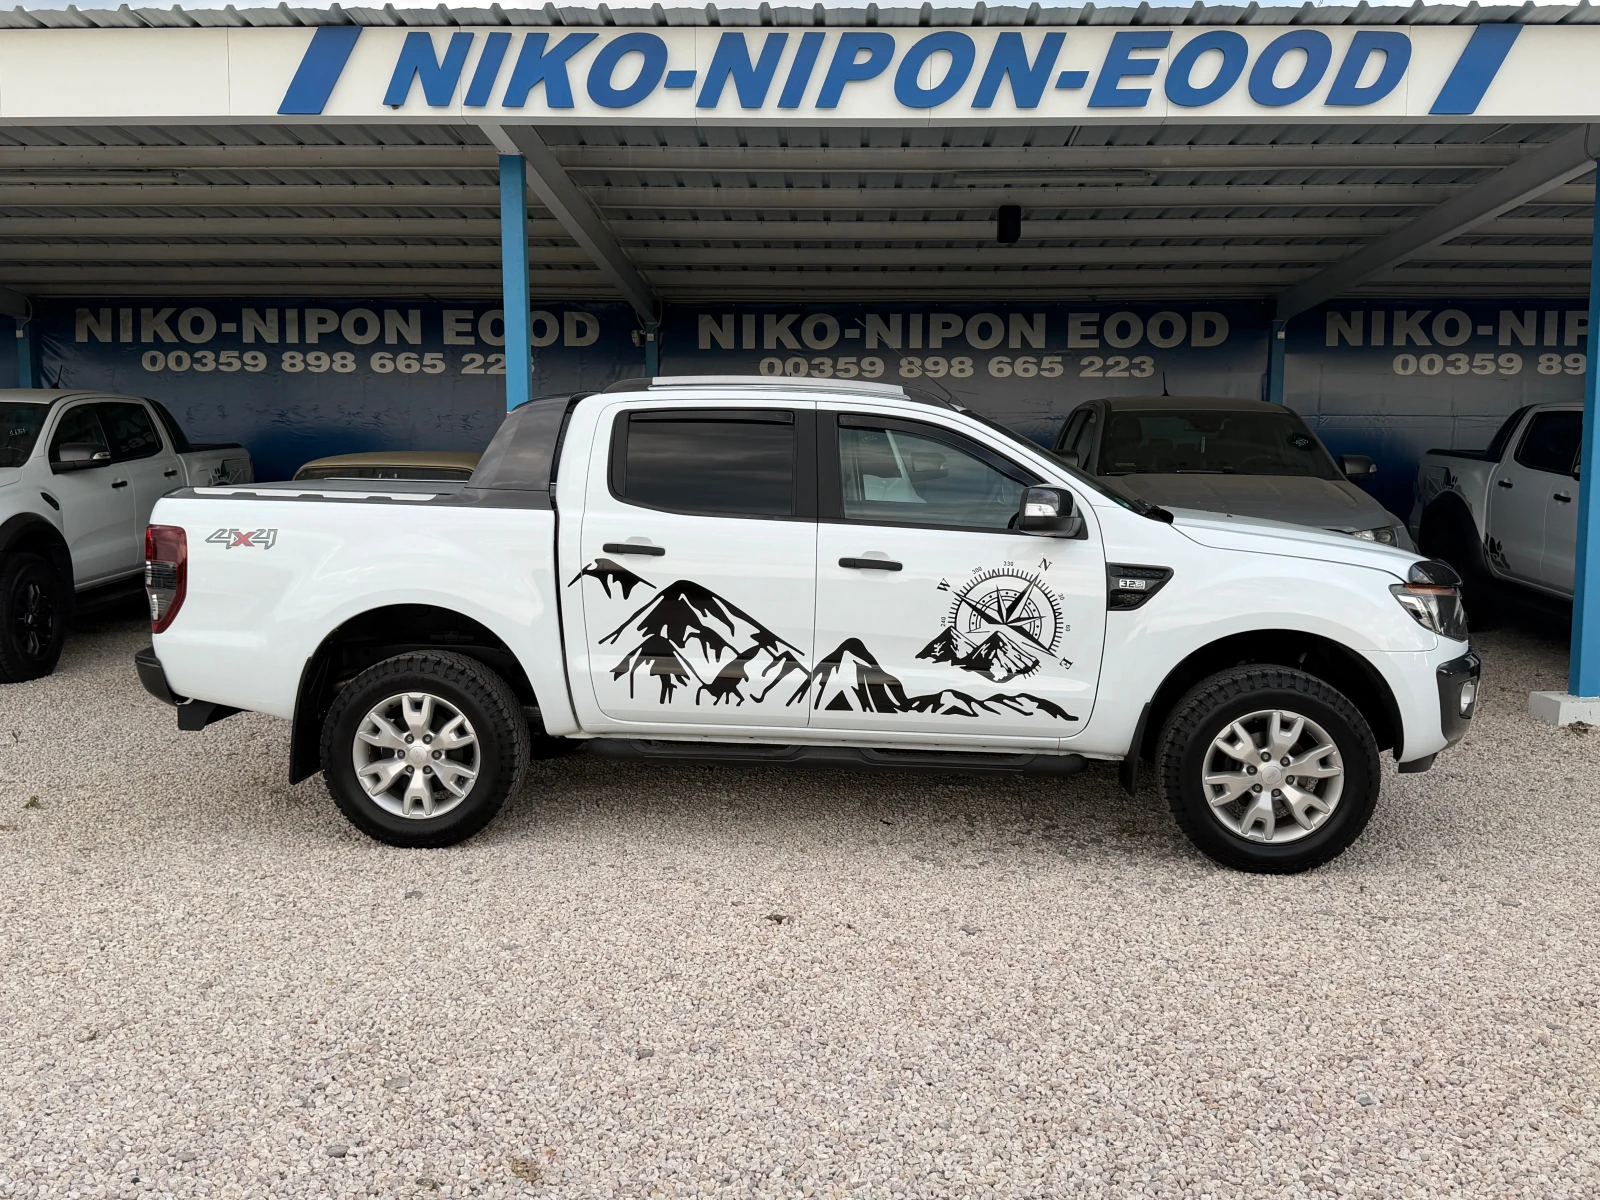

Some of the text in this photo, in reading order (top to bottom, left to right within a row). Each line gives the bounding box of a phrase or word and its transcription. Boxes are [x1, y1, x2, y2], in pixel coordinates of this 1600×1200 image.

[383, 30, 1412, 109] NIKO-NIPON-EOOD
[75, 307, 423, 346] NIKO-NIPON
[697, 311, 1230, 350] NIKO-NIPON EOOD
[141, 350, 535, 375] 00359 898 665 22
[759, 356, 1155, 379] 00359 898 665 223
[1392, 353, 1523, 375] 00359
[972, 566, 983, 575] 300
[1037, 557, 1053, 572] N
[936, 578, 952, 592] W
[1059, 656, 1074, 670] E
